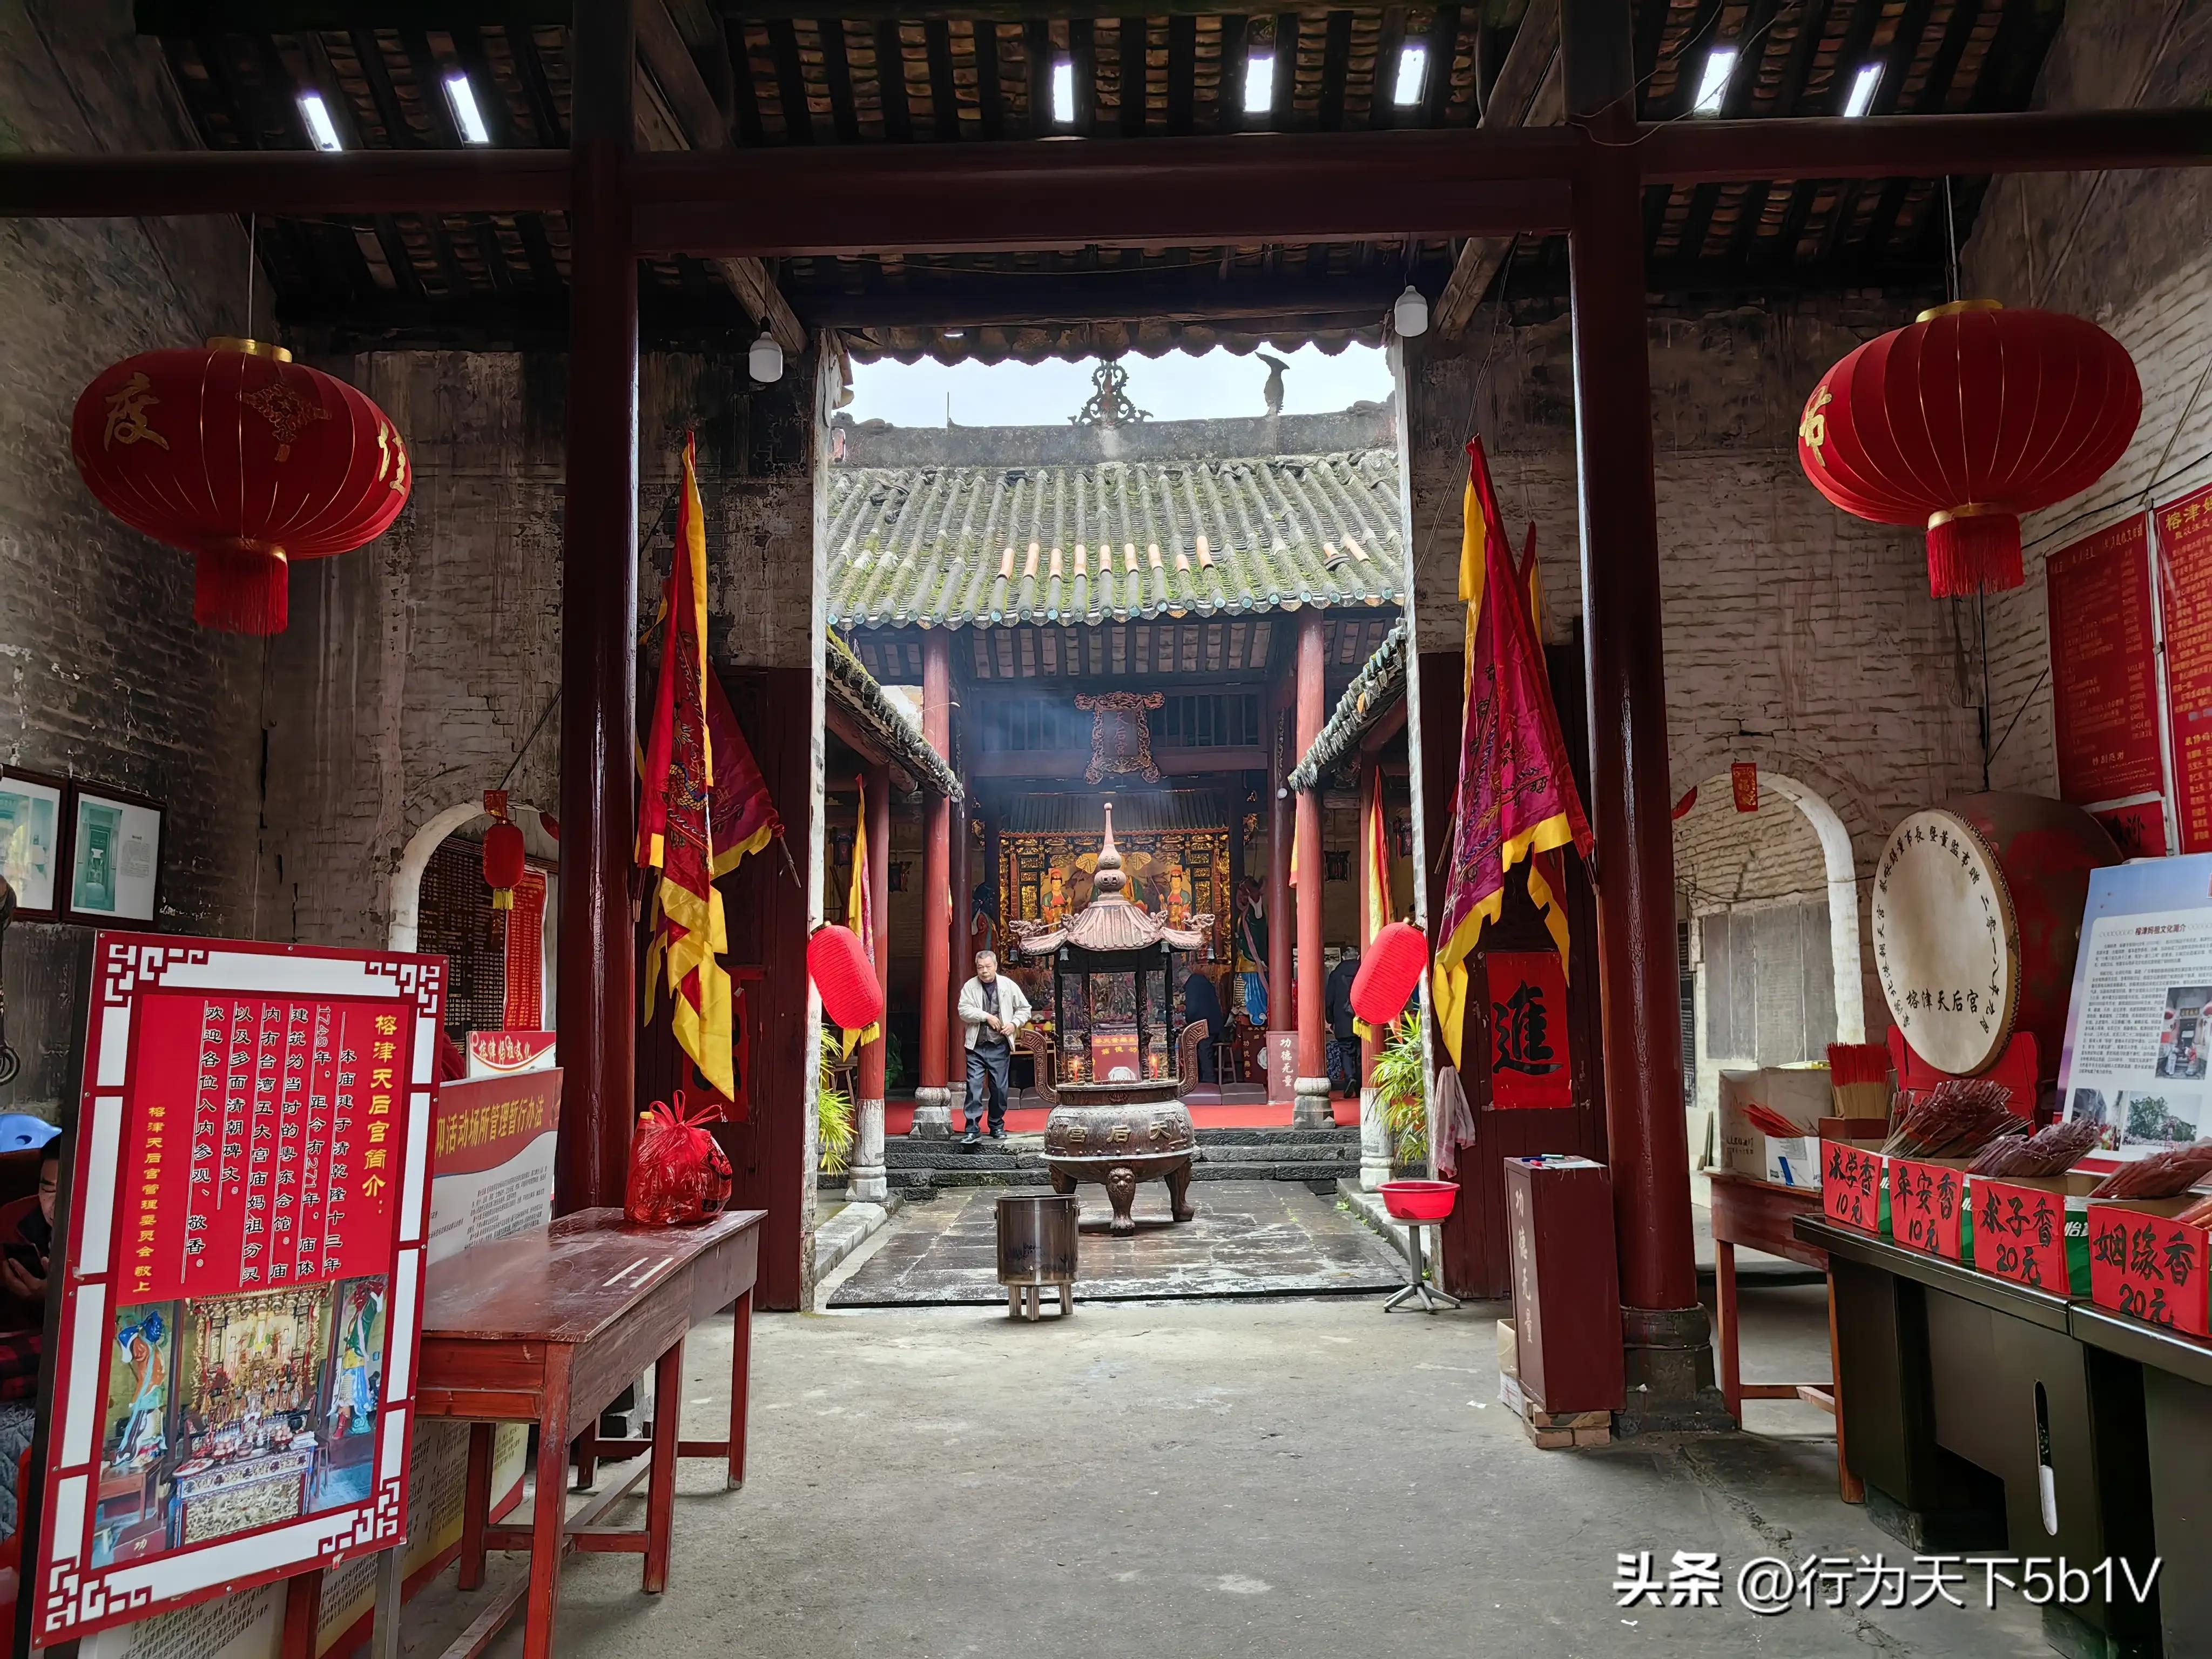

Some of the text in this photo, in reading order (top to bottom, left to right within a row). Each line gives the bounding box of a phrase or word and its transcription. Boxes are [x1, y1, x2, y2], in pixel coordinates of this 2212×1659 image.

[1492, 979, 1564, 1076] 進
[1279, 1037, 1294, 1087] 功德无量
[221, 1007, 253, 1195] 以及多面清朝碑文。
[241, 1006, 281, 1282] 内有台湾五大宫庙妈祖分灵
[323, 1049, 358, 1272] 本庙建于清乾隆十三年
[1836, 1192, 1863, 1225] 10元
[1894, 1165, 1957, 1220] 平安香
[1980, 1186, 2055, 1249] 求子香
[1515, 1188, 1533, 1344] 功德无量
[1909, 1218, 1940, 1253] 10元
[1995, 1243, 2043, 1288] 20元
[2093, 1222, 2195, 1287] 姻缘香
[2119, 1283, 2174, 1327] 20元
